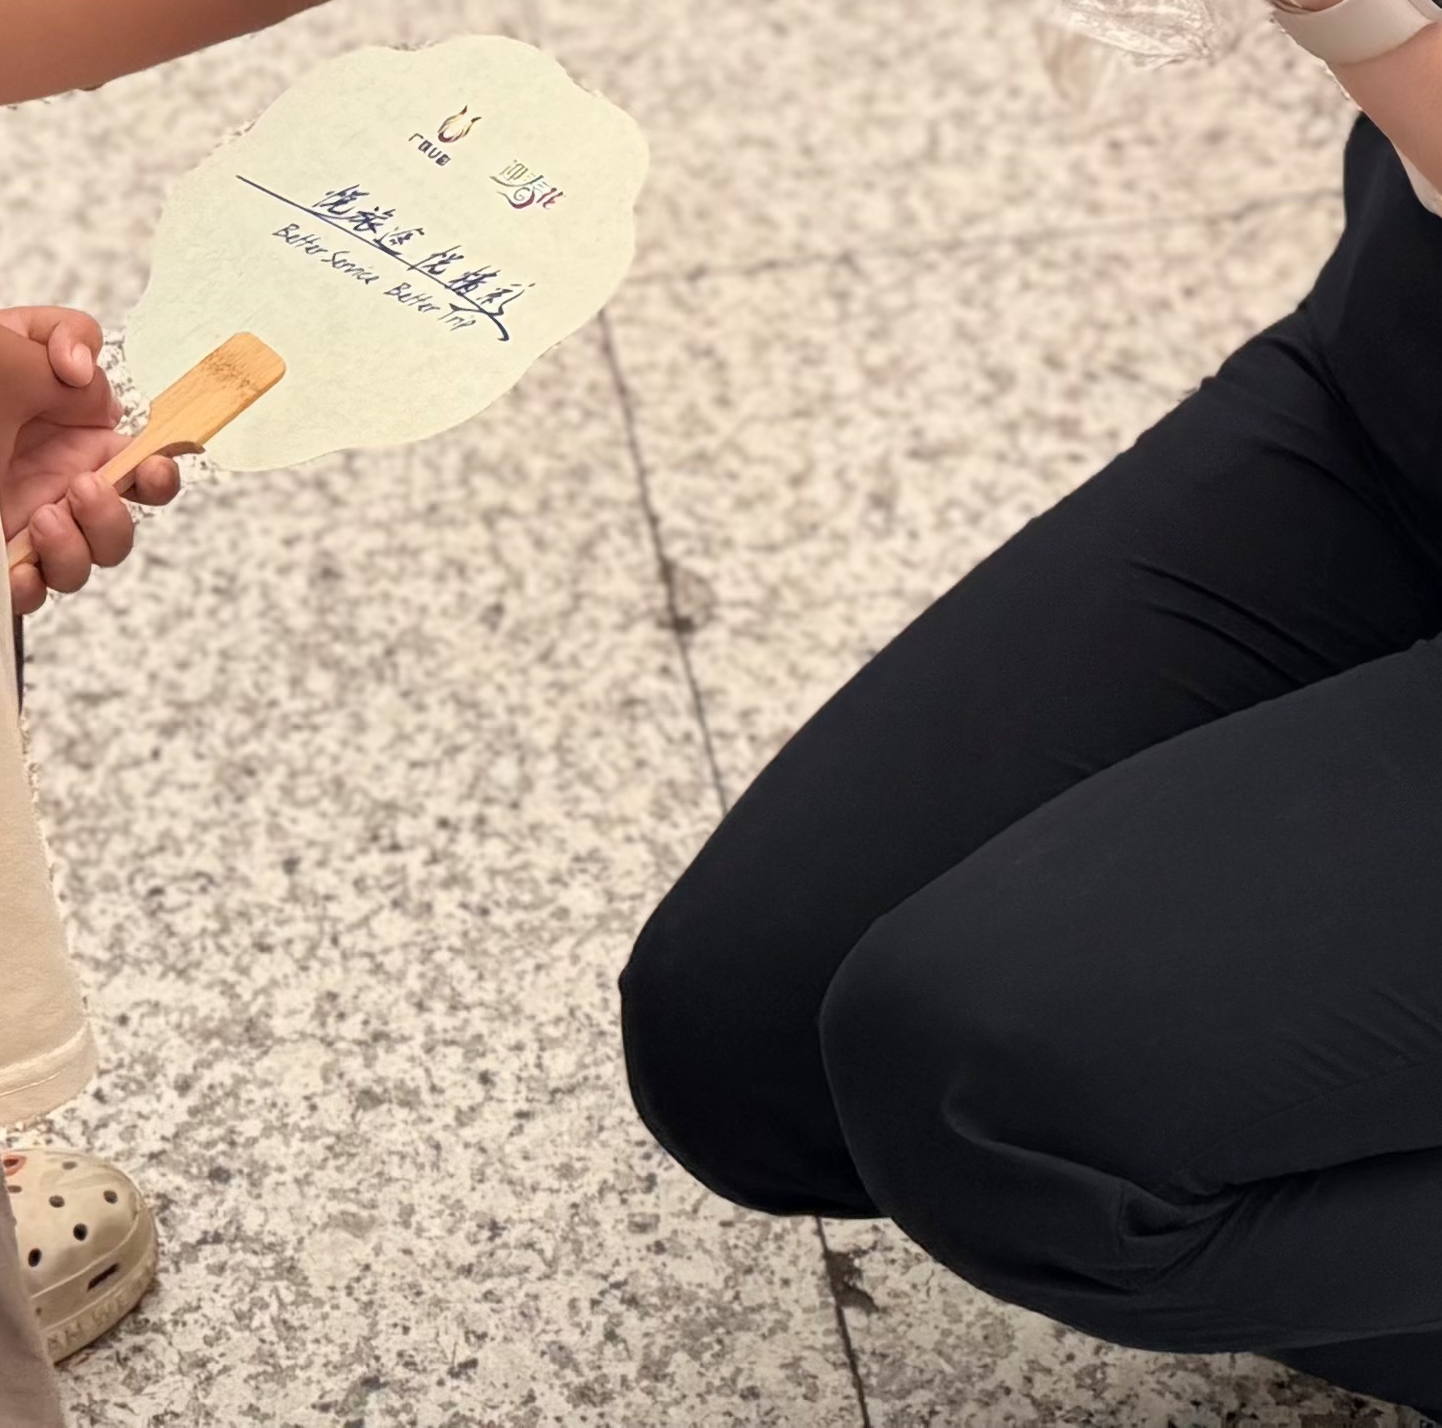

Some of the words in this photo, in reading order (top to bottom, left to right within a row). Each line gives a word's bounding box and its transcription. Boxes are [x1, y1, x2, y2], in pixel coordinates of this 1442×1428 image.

[272, 223, 328, 256] Better
[321, 251, 381, 286] Service
[383, 282, 441, 314] Better
[438, 303, 477, 332] Trip
